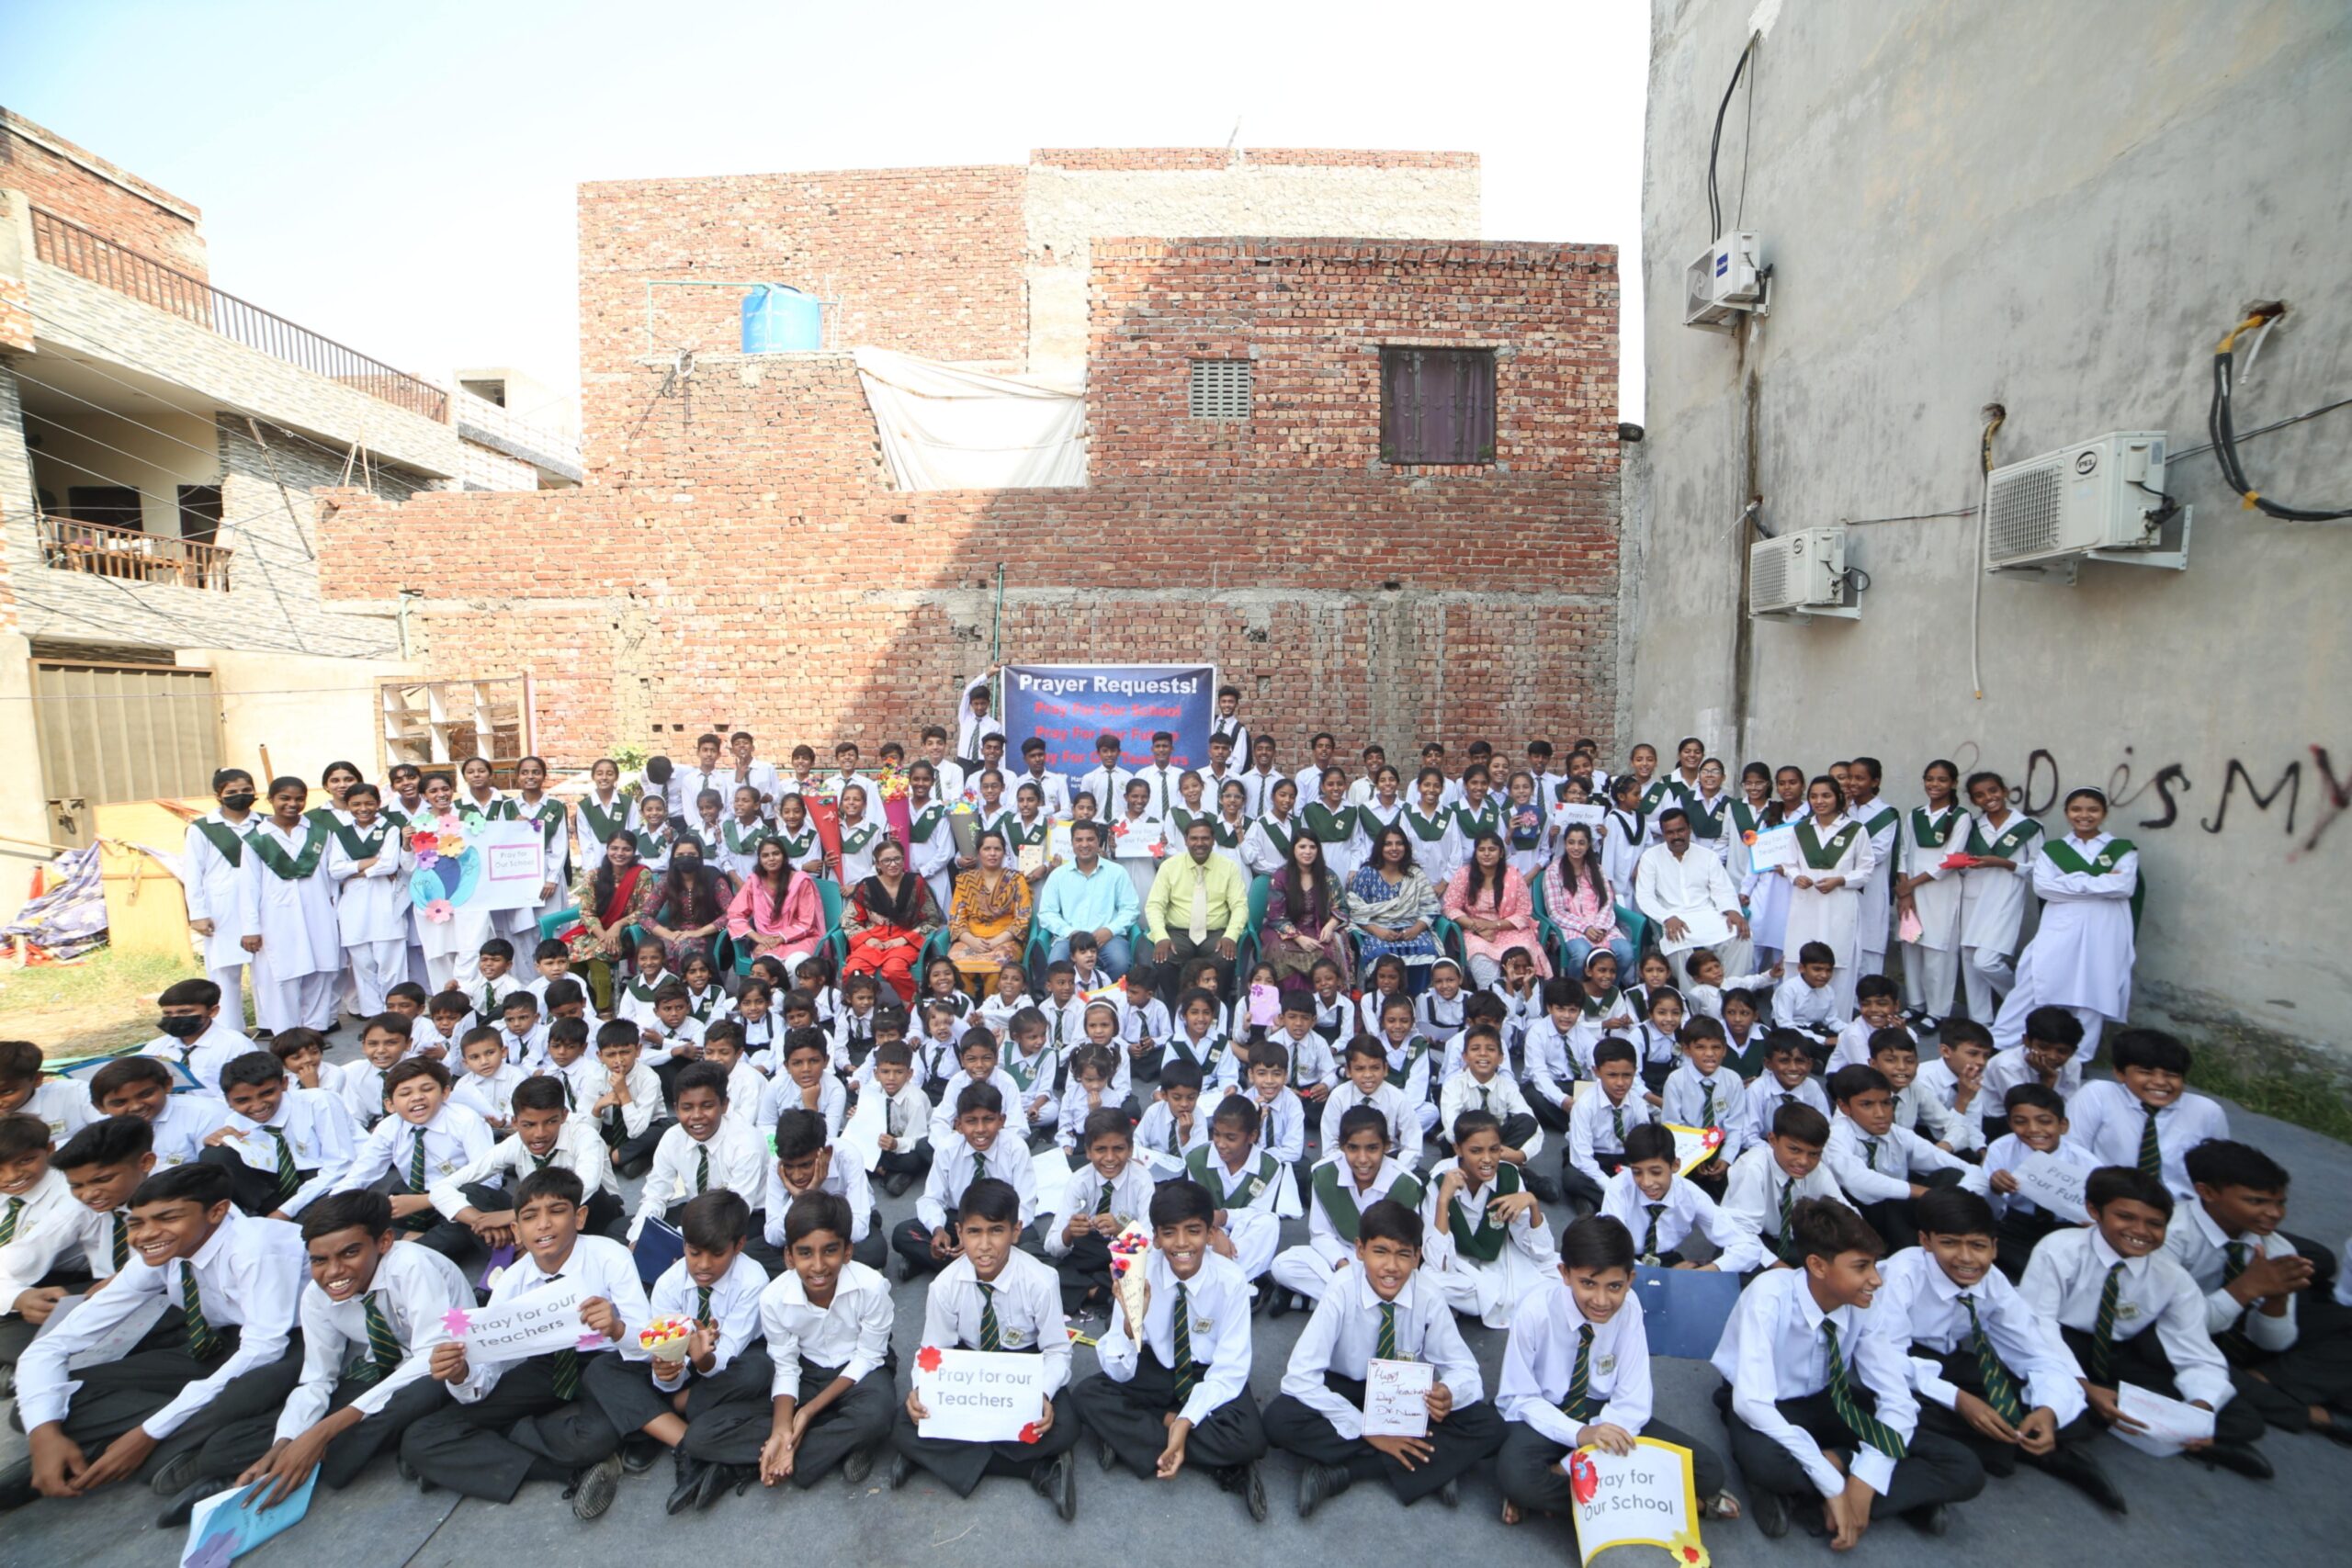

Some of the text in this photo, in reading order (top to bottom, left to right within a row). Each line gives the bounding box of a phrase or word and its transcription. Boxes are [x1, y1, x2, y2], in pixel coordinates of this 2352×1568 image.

[2078, 459, 2093, 468] PEL
[1019, 674, 1197, 696] Prayer Requests!
[1034, 701, 1182, 718] Pray For Our School
[1035, 726, 1068, 743] Pray
[1072, 726, 1095, 739] For
[1062, 750, 1086, 763] For
[500, 852, 516, 860] Pray
[2047, 1167, 2080, 1187] Pray
[2055, 1187, 2085, 1206] Futu
[469, 1293, 577, 1335] Pray for our
[477, 1318, 565, 1348] Teachers
[937, 1367, 1033, 1385] Pray for our
[937, 1391, 1014, 1408] Teachers
[1599, 1469, 1655, 1489] ray for
[1584, 1494, 1674, 1522] Our School
